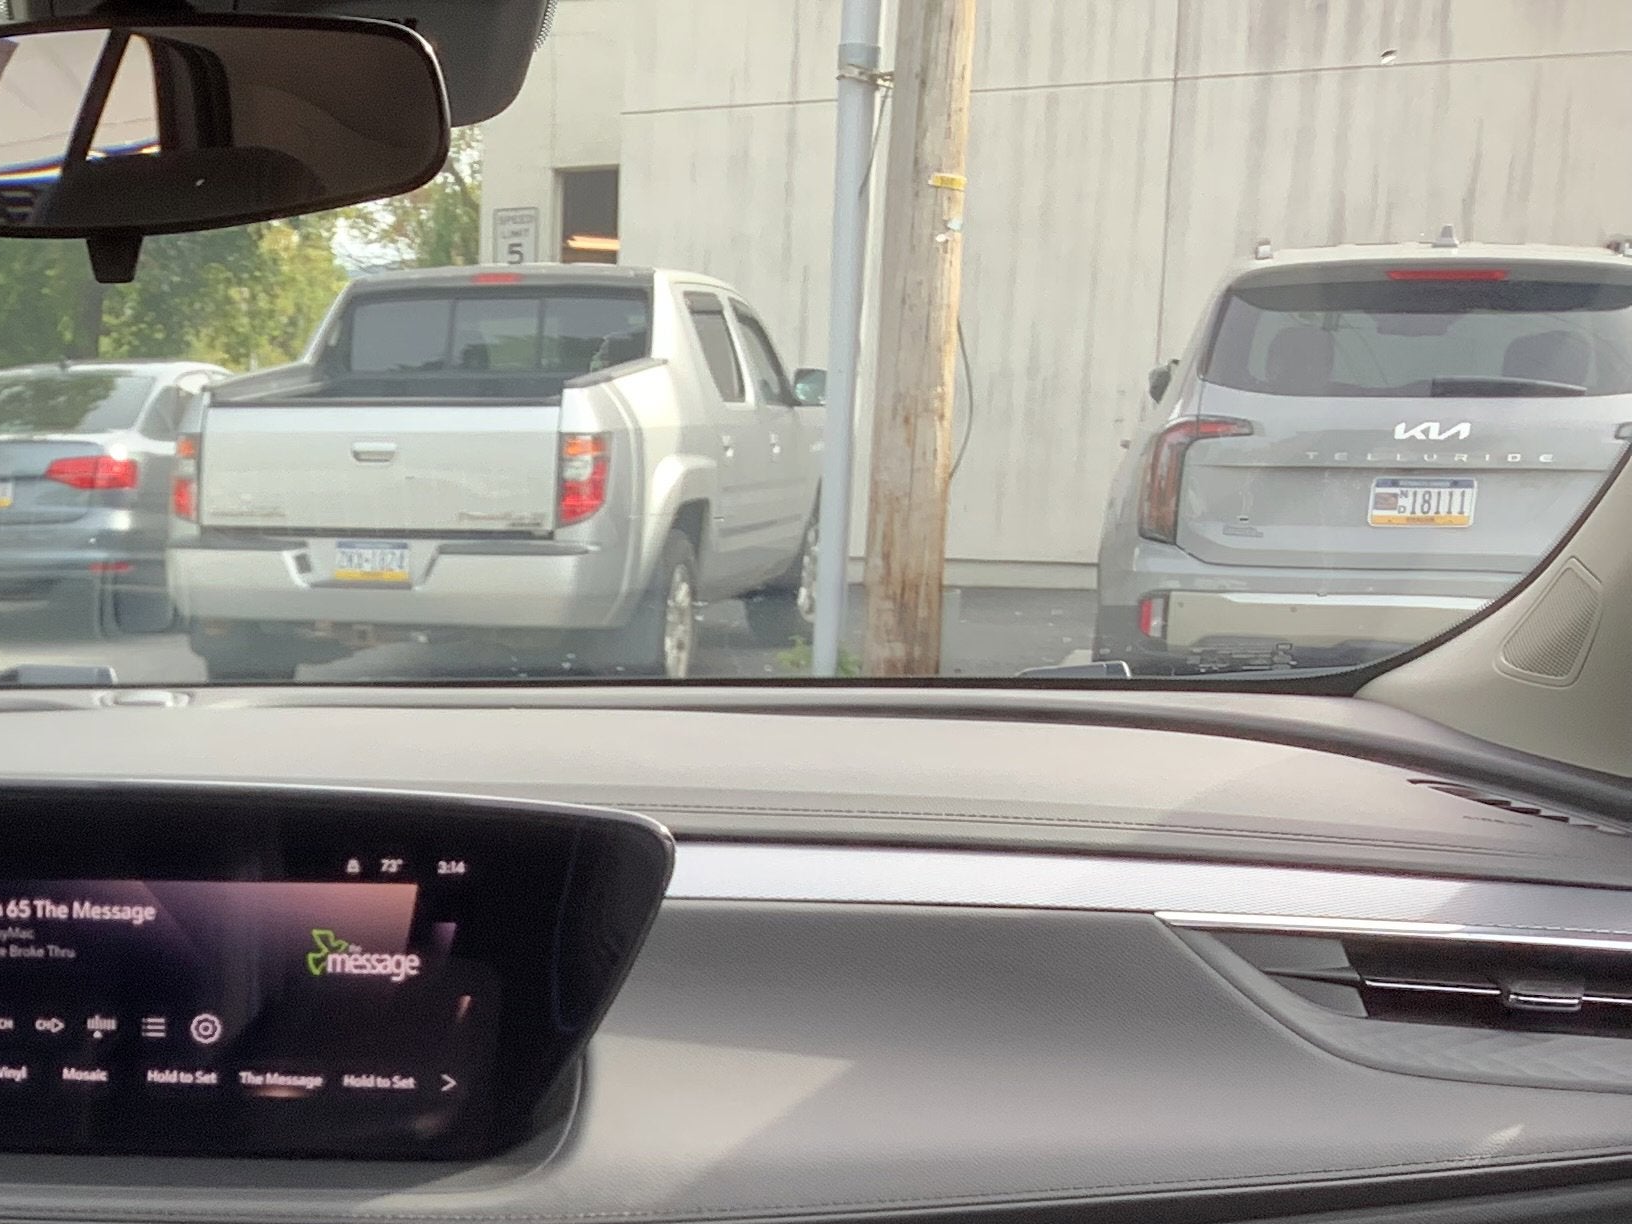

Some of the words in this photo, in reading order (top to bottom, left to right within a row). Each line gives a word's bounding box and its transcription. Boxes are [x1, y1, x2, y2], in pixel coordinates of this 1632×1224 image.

[507, 243, 524, 264] 5
[1394, 421, 1472, 440] KIA
[1305, 452, 1555, 463] TELLURIDE
[1409, 490, 1466, 515] 18111
[5, 899, 32, 919] 65
[33, 899, 69, 920] The
[72, 901, 157, 926] Message
[326, 953, 420, 983] message
[61, 1066, 109, 1082] Mosaic
[146, 1068, 178, 1084] Hold
[179, 1070, 194, 1084] to
[195, 1070, 217, 1085] Set
[238, 1071, 264, 1086] The
[265, 1072, 324, 1090] Message
[342, 1073, 375, 1088] Hold
[376, 1075, 391, 1089] to
[392, 1074, 416, 1090] Set
